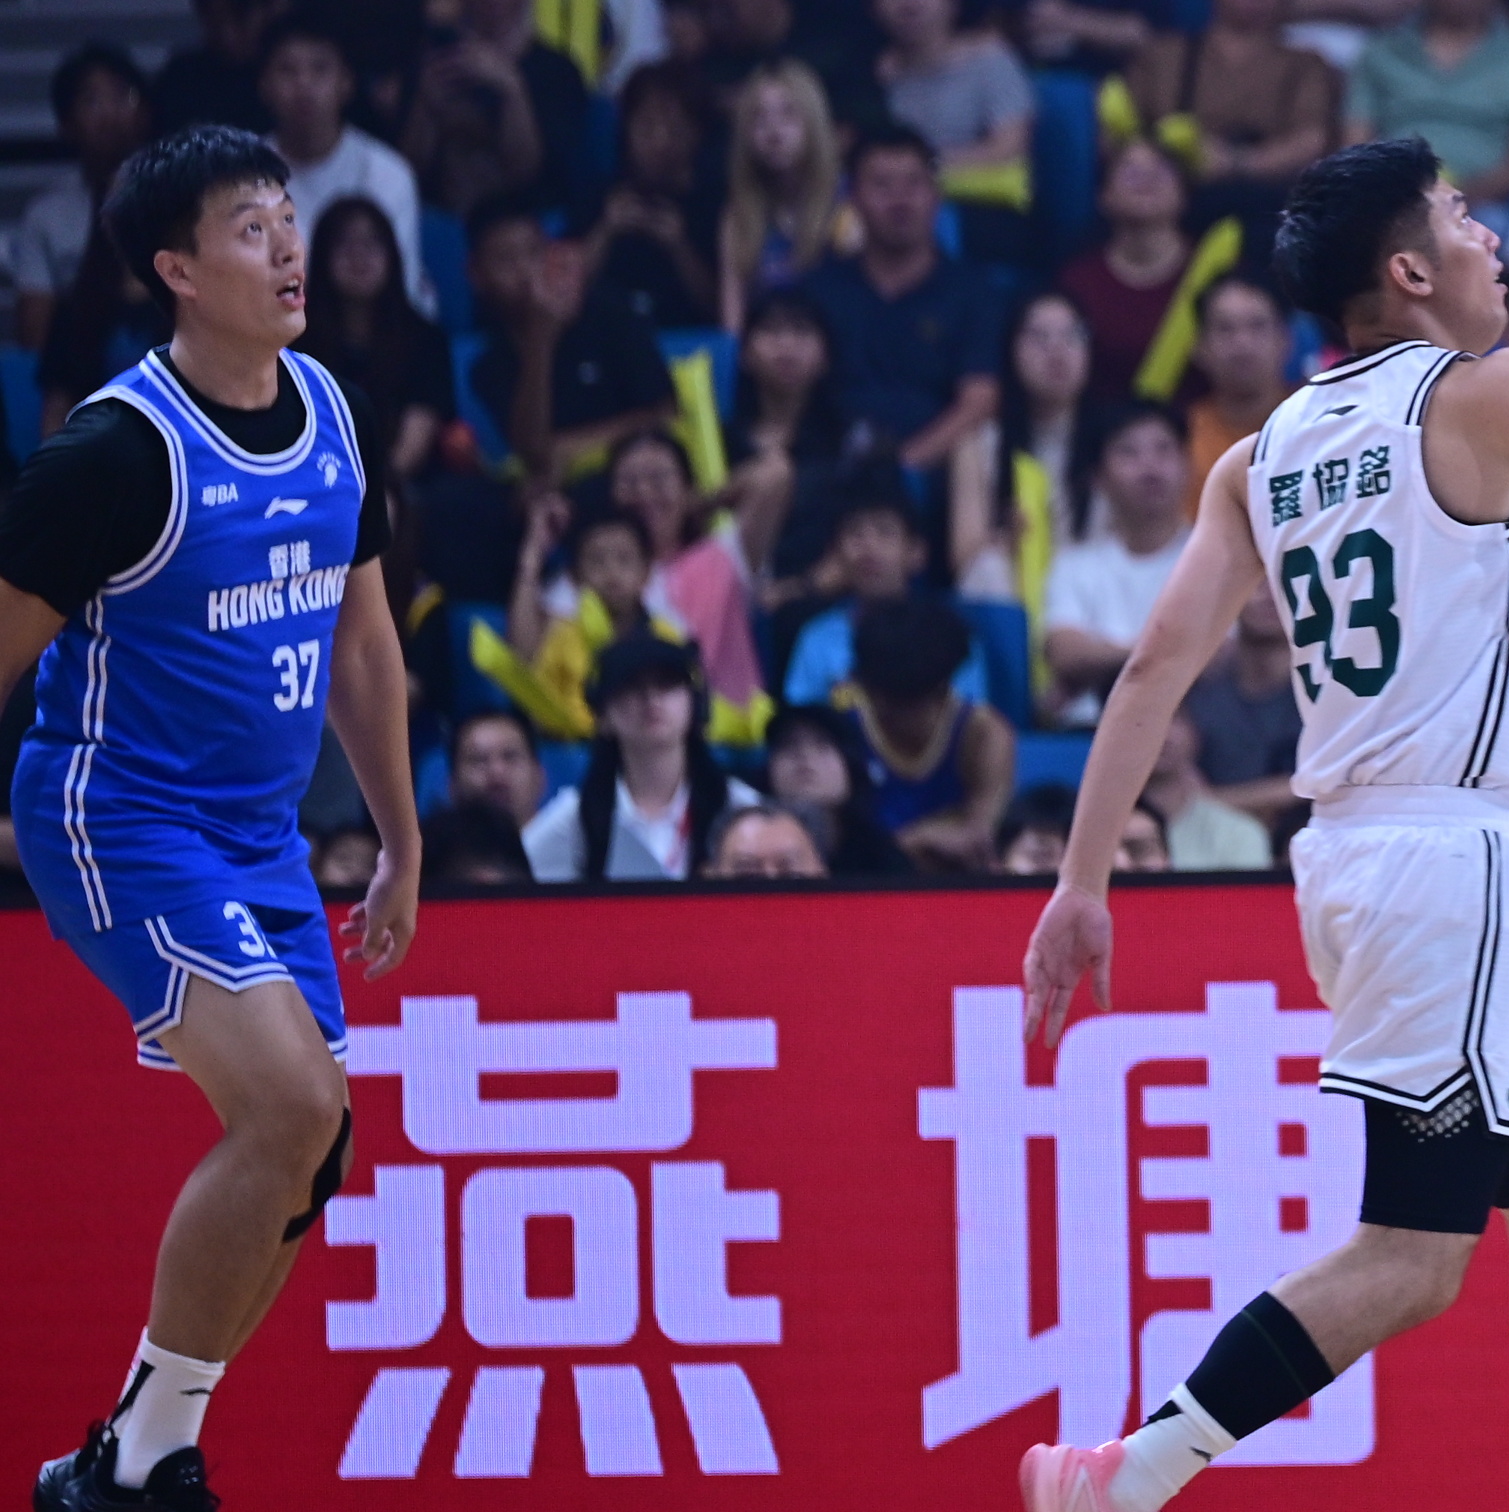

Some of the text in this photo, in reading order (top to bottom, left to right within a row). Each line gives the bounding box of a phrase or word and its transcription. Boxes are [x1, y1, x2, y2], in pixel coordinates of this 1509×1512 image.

[207, 577, 286, 633] HONG
[1280, 527, 1400, 704] 93
[271, 638, 320, 713] 37
